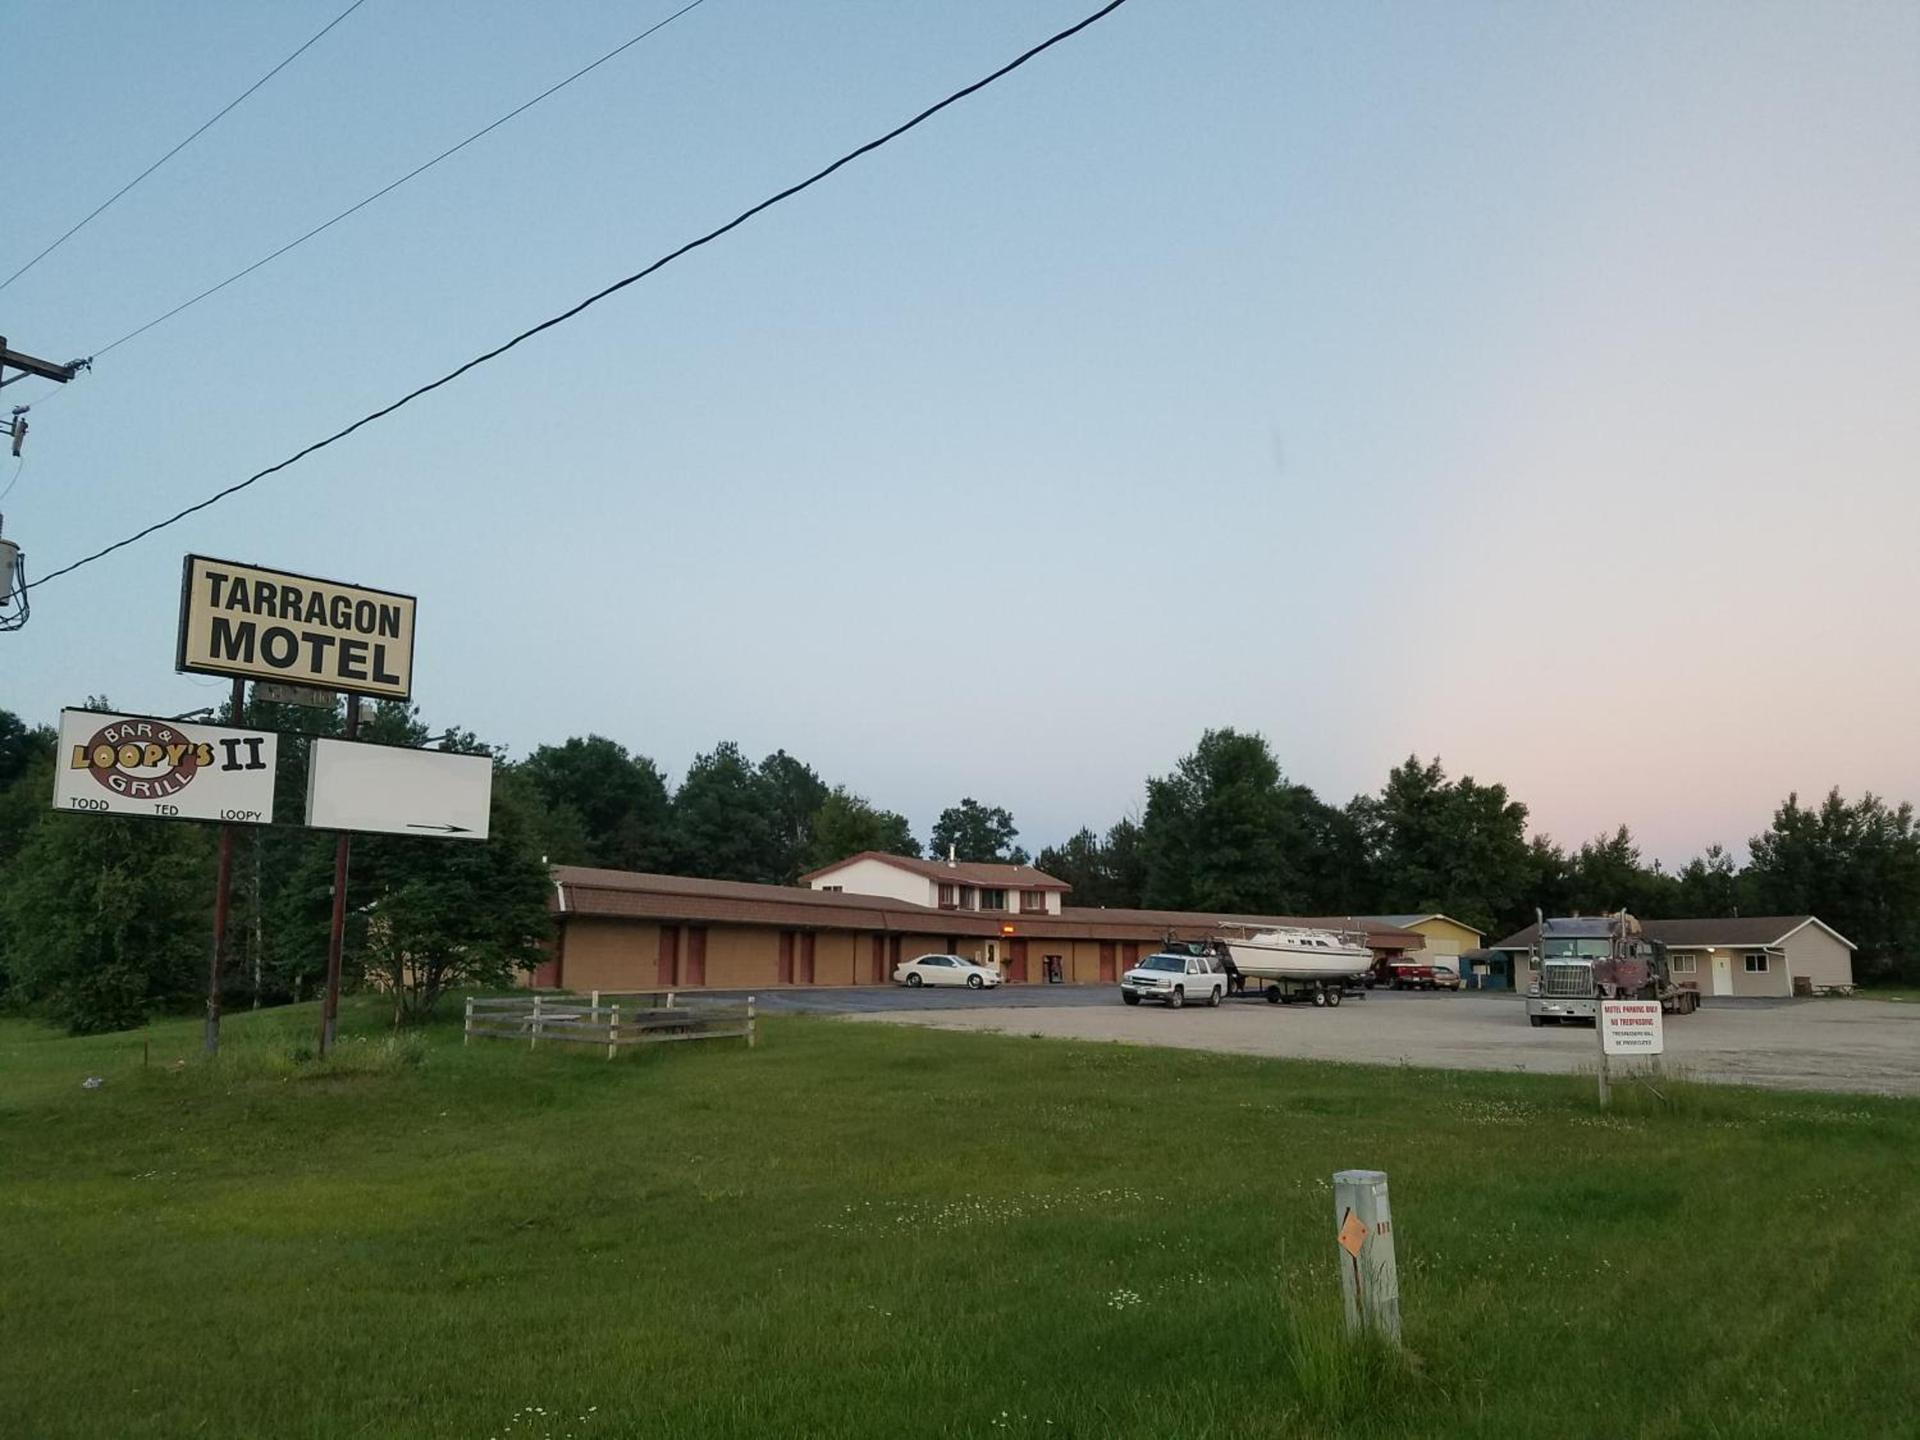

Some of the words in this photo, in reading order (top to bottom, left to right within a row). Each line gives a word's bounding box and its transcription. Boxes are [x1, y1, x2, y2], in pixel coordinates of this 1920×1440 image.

[205, 571, 401, 639] TARRAGON
[209, 616, 401, 686] MOTEL
[104, 723, 152, 744] BAR
[157, 730, 174, 743] &
[71, 742, 215, 770] LOOPY'S
[219, 737, 267, 771] II
[108, 771, 193, 797] GRILL
[70, 797, 110, 811] TODD
[154, 804, 179, 816] TED
[220, 809, 262, 821] LOOPY
